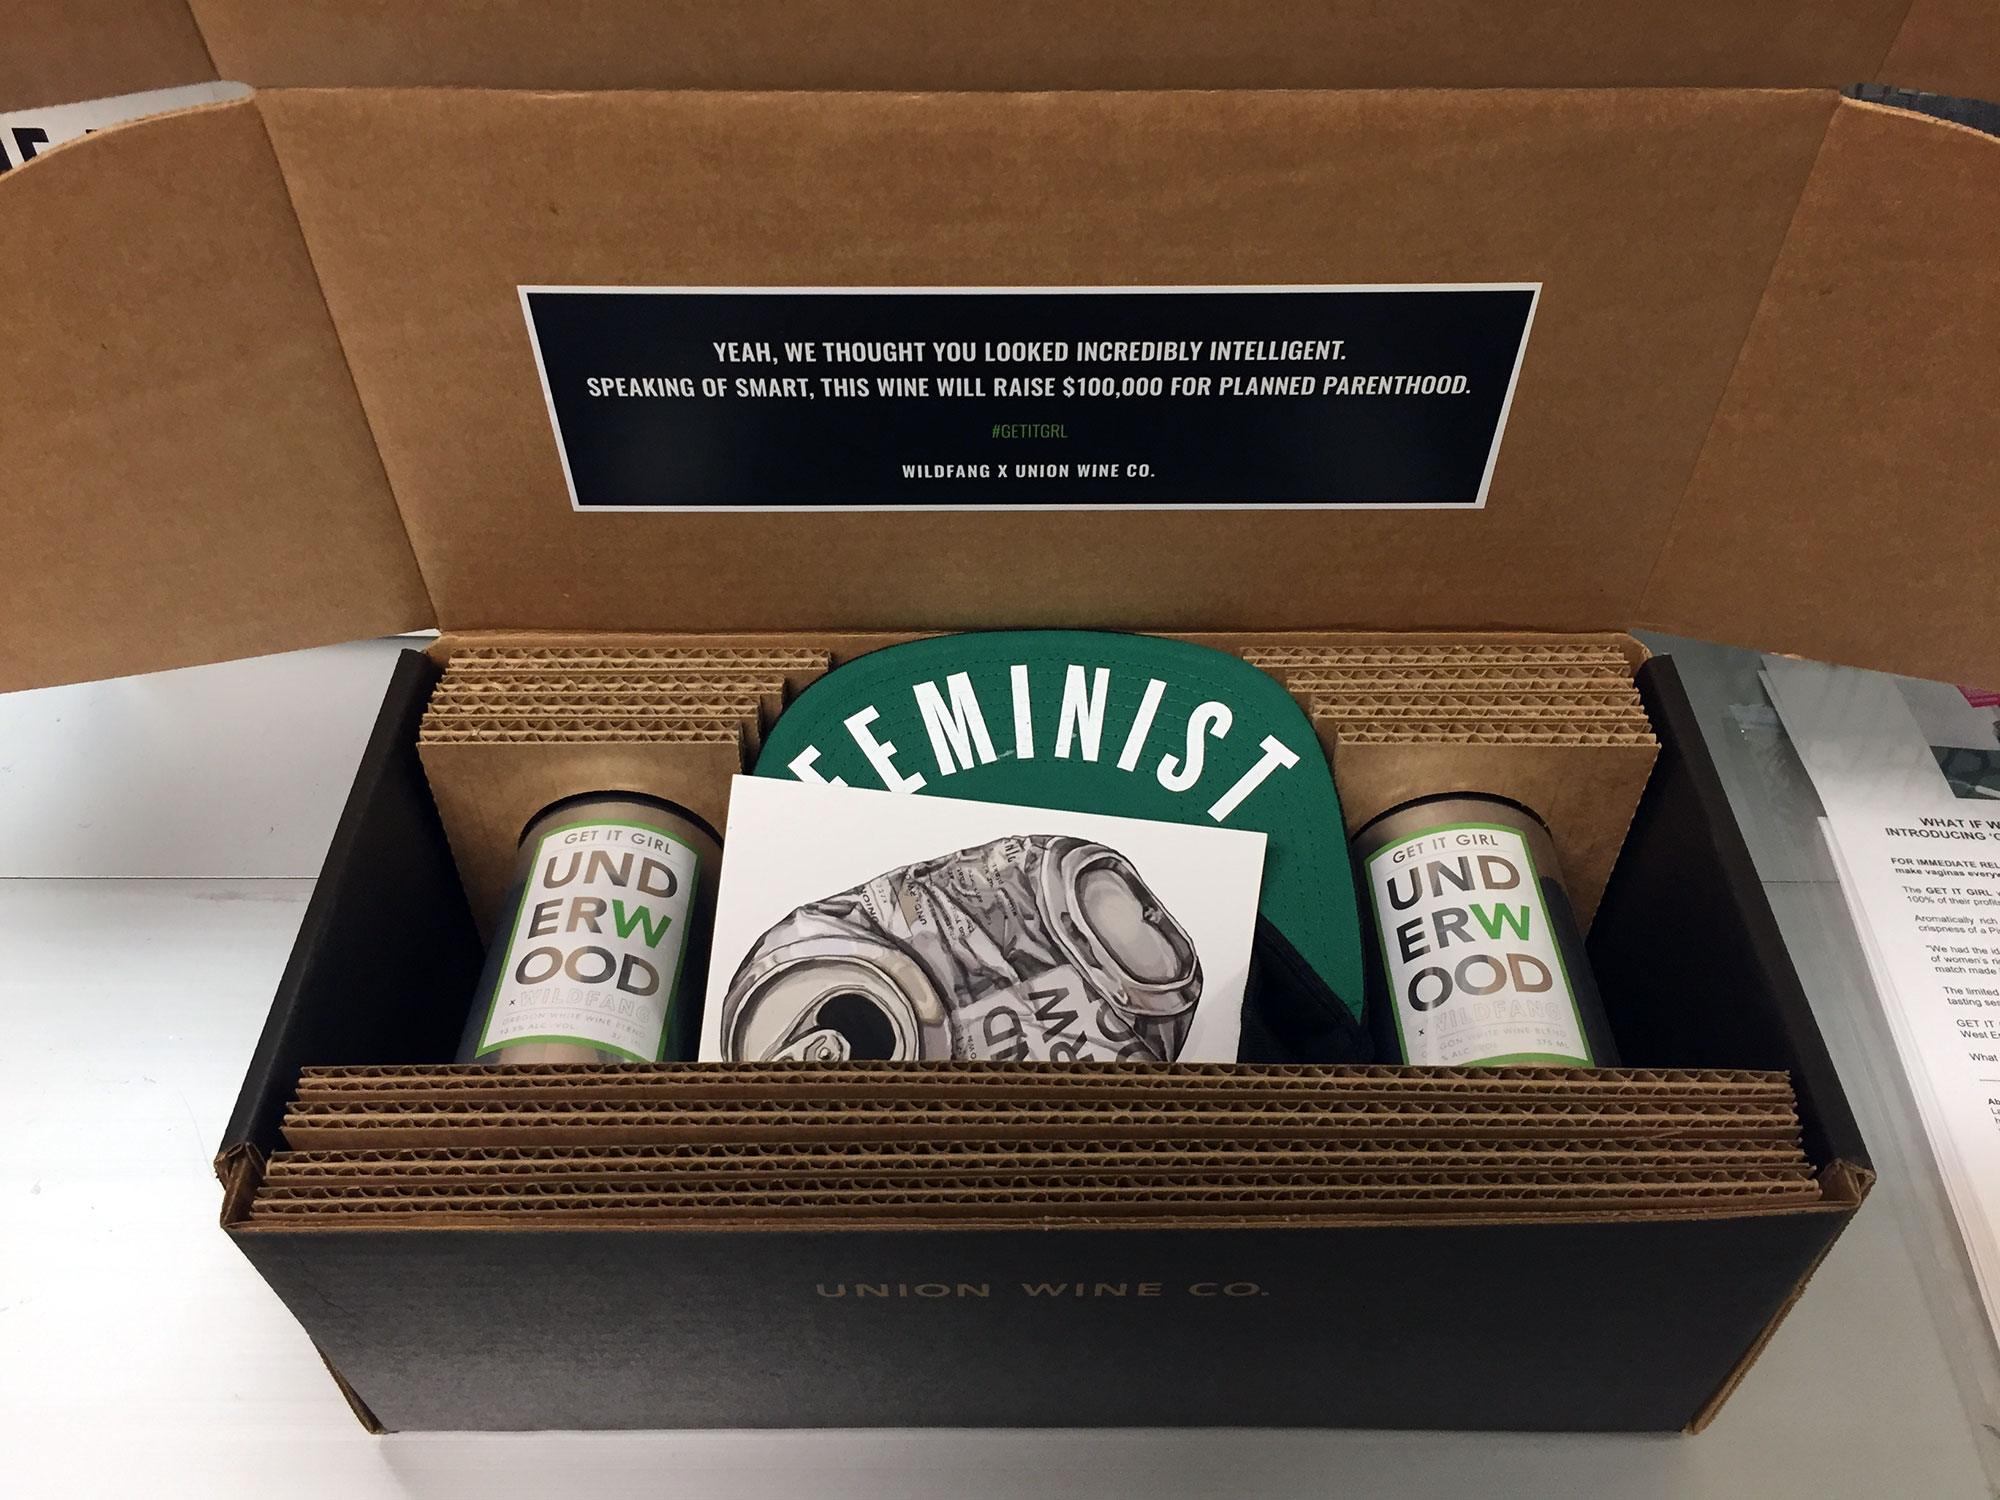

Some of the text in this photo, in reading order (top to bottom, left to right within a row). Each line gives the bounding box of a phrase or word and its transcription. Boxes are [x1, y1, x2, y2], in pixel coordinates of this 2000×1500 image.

[713, 340, 1346, 365] YEAH, WE THOUGHT YOU LOOKED INCREDIBLY INTELLIGENT.
[586, 375, 1471, 400] SPEAKING OF SMART, THIS WINE WILL RAISE $100,000 FOR PLANNED PARENTHOOD.
[992, 424, 1068, 439] #GETITGRL
[902, 463, 1156, 479] WILDFANG X UNION WINE CO.
[786, 664, 1301, 822] FEMINIST
[1918, 817, 1965, 828] WHAT
[1968, 820, 1982, 829] IF
[1885, 827, 1986, 841] INTRODUCING
[564, 830, 672, 856] GET IT GIRL
[1392, 834, 1499, 864] GET IT GIRL
[1890, 857, 1914, 865] FOR
[1916, 858, 1977, 869] IMMEDIATE
[543, 850, 678, 898] UND
[1895, 867, 1923, 875] make
[1925, 868, 1965, 877] vaginas
[1387, 855, 1521, 911] UND
[1902, 885, 1993, 897] The GET IT GIRL
[1907, 895, 1935, 904] 100%
[1937, 896, 1947, 904] of
[1948, 897, 1970, 905] their
[527, 896, 672, 949] ERW
[1915, 914, 1998, 925] Aromatically rich
[1396, 903, 1530, 964] ERW
[1918, 925, 1966, 933] crispness
[1967, 926, 1977, 934] of
[1949, 946, 1970, 954] had
[1971, 947, 1988, 955] the
[1943, 957, 1989, 965] women's
[515, 945, 660, 997] OOD
[1935, 966, 1997, 975] match made
[1407, 953, 1553, 1012] OOD
[1942, 986, 1999, 996] The limited
[521, 988, 649, 1023] WILDFANG
[1947, 996, 1983, 1008] tasting
[585, 1015, 612, 1026] WINE
[1956, 1019, 1995, 1029] GET IT
[1503, 1026, 1531, 1035] WINE
[1960, 1029, 1989, 1039] West
[1968, 1052, 1999, 1062] What
[815, 1282, 1270, 1298] UNION WINE CO.
